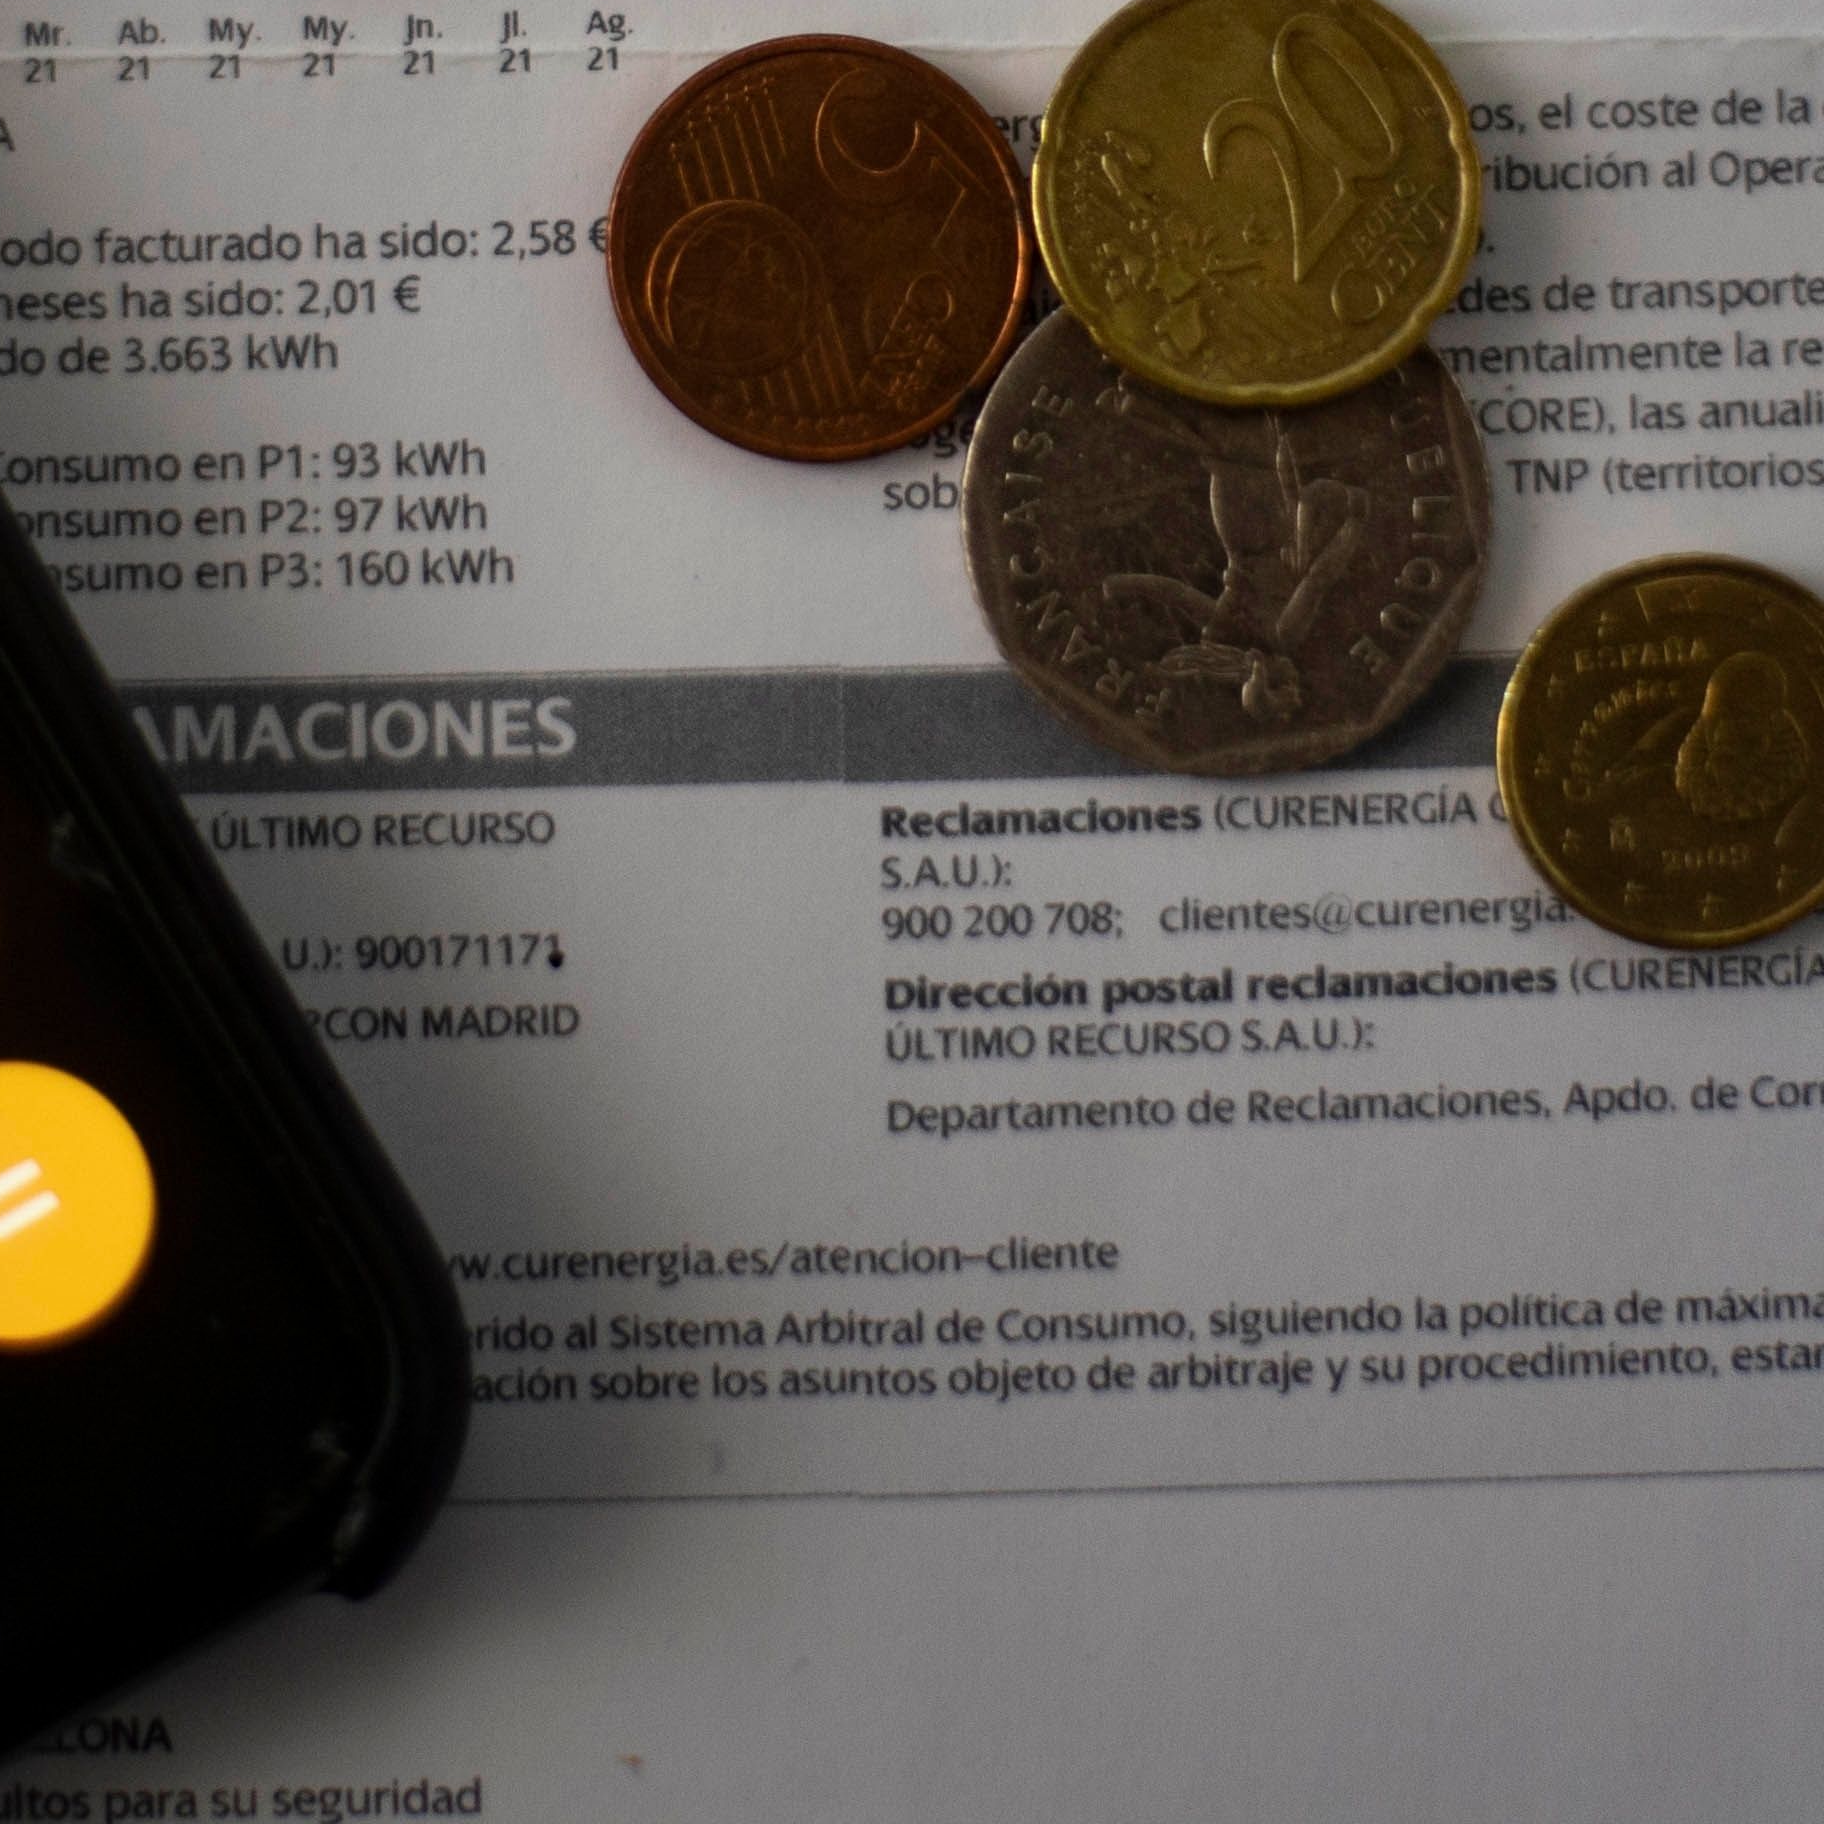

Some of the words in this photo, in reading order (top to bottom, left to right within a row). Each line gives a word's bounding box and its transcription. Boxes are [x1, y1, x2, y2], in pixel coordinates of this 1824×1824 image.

[1537, 92, 1575, 132] el
[1587, 95, 1701, 131] coste
[1711, 88, 1765, 127] de
[1776, 88, 1813, 125] la
[1203, 13, 1402, 283] 20
[119, 281, 172, 320] ha
[183, 278, 284, 320] sido:
[296, 277, 376, 319] 2,01
[391, 273, 421, 315] €
[881, 798, 1203, 840] Reclamaciones
[1214, 791, 1478, 831] (CURENERGÍA
[881, 905, 954, 942] 900
[964, 903, 1035, 940] 200
[1045, 900, 1123, 939] 708;
[887, 1097, 1176, 1139] Departamento
[1186, 1090, 1236, 1127] de
[1247, 1088, 1551, 1124] Reclamaciones,
[1563, 1079, 1676, 1122] Apdo.
[1689, 1075, 1740, 1113] de
[1209, 1297, 1403, 1347] siguiendo
[1414, 1297, 1449, 1333] la
[1459, 1294, 1606, 1339] política
[1614, 1289, 1665, 1327] de
[103, 1788, 202, 1824] para
[209, 1787, 260, 1821] su
[270, 1776, 485, 1824] seguridad
